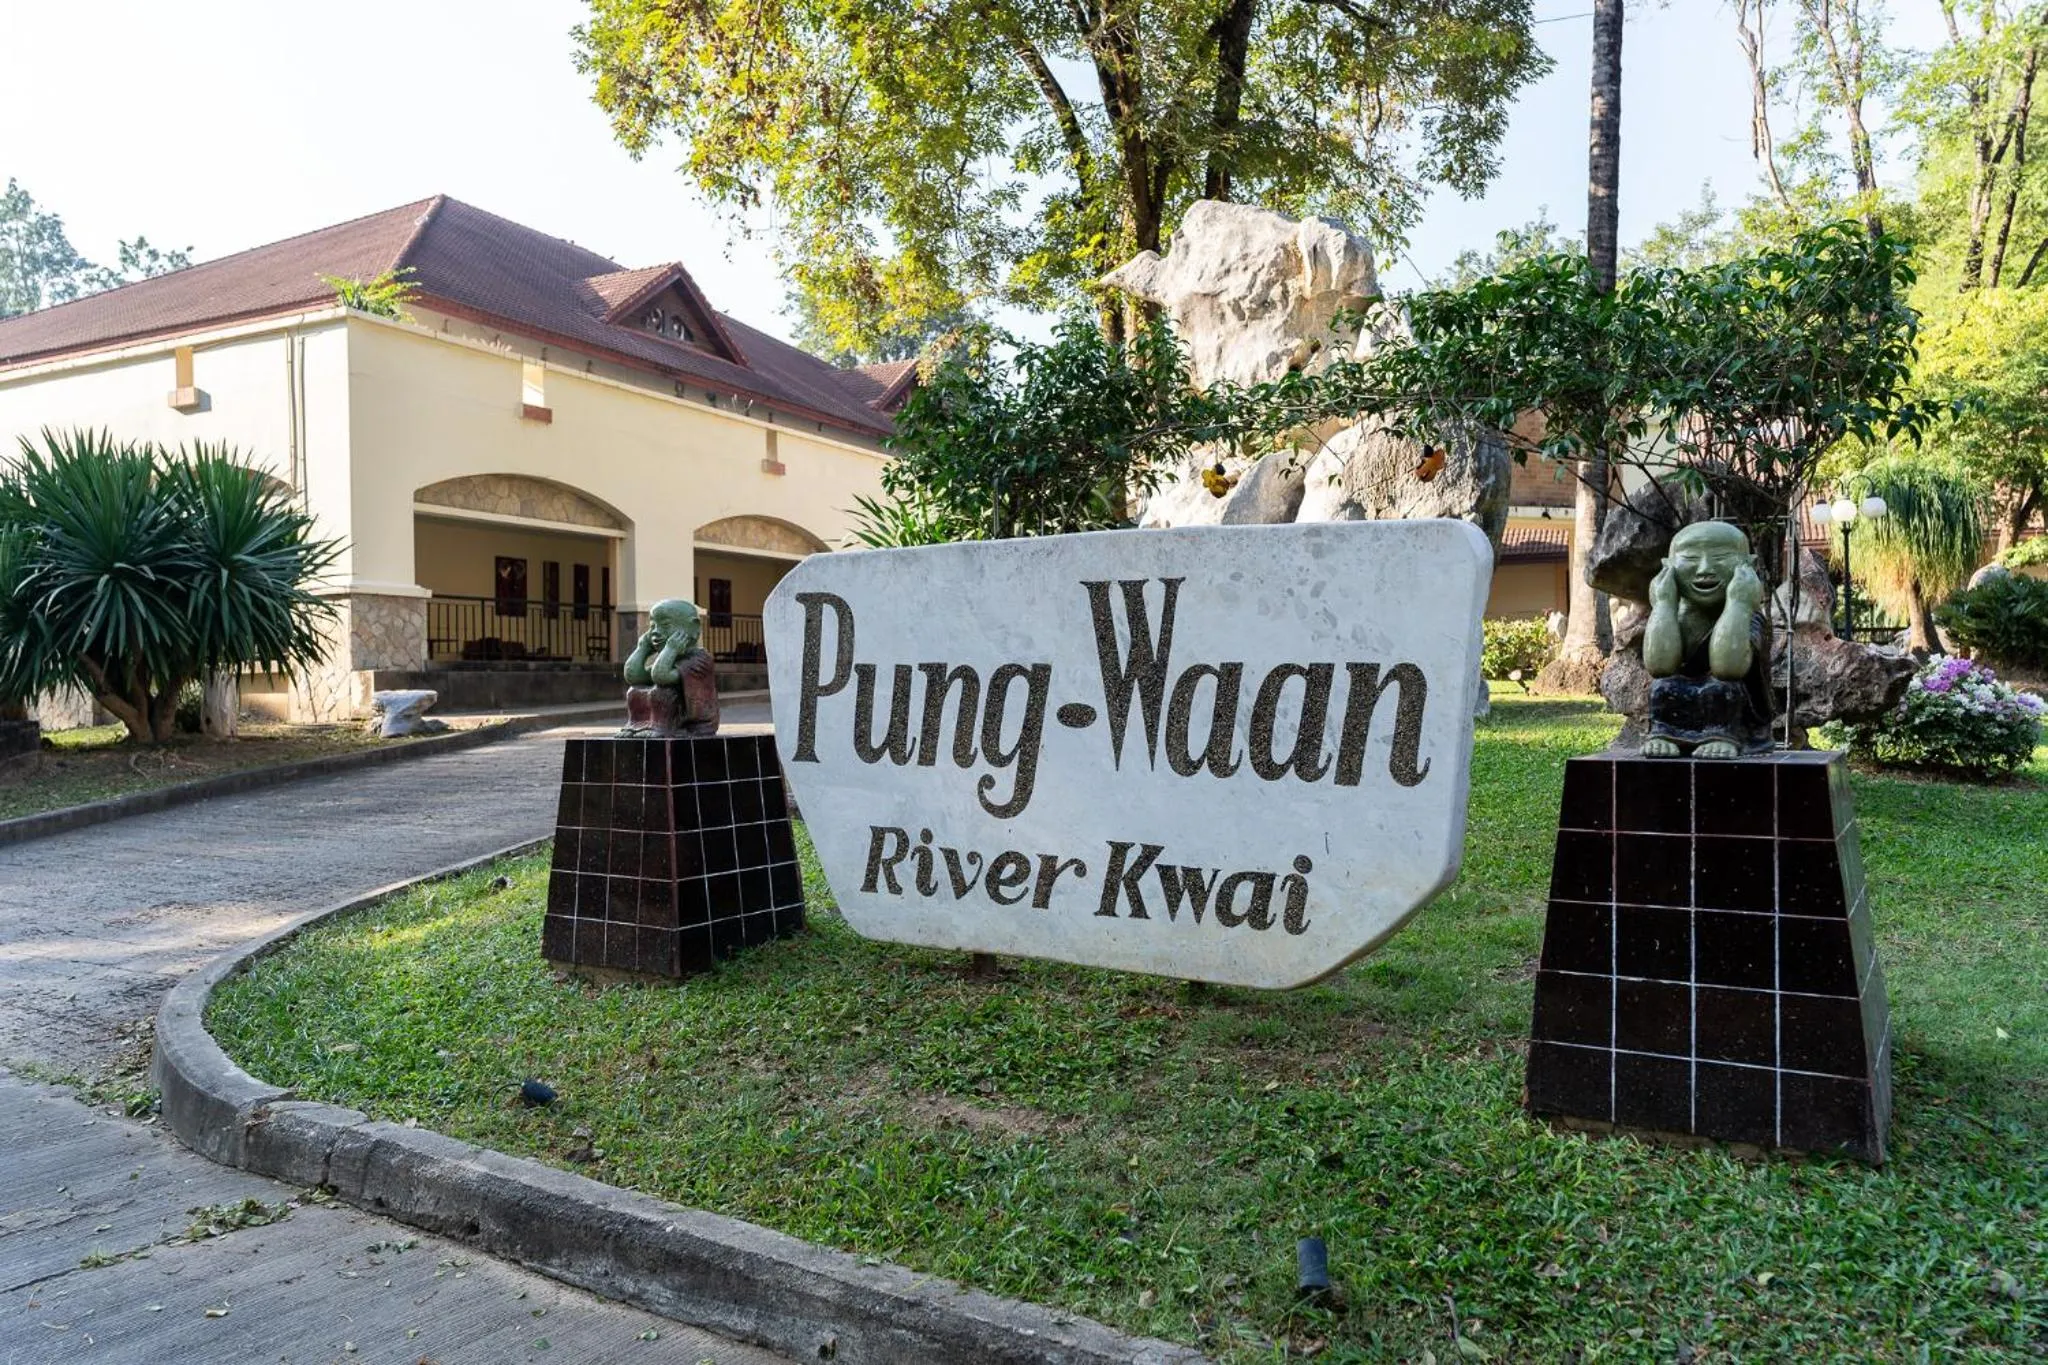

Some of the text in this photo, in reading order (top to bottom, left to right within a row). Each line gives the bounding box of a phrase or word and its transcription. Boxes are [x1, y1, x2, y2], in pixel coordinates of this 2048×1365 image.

[791, 576, 1431, 819] Pung-Waan
[859, 825, 1314, 936] River Kwai
